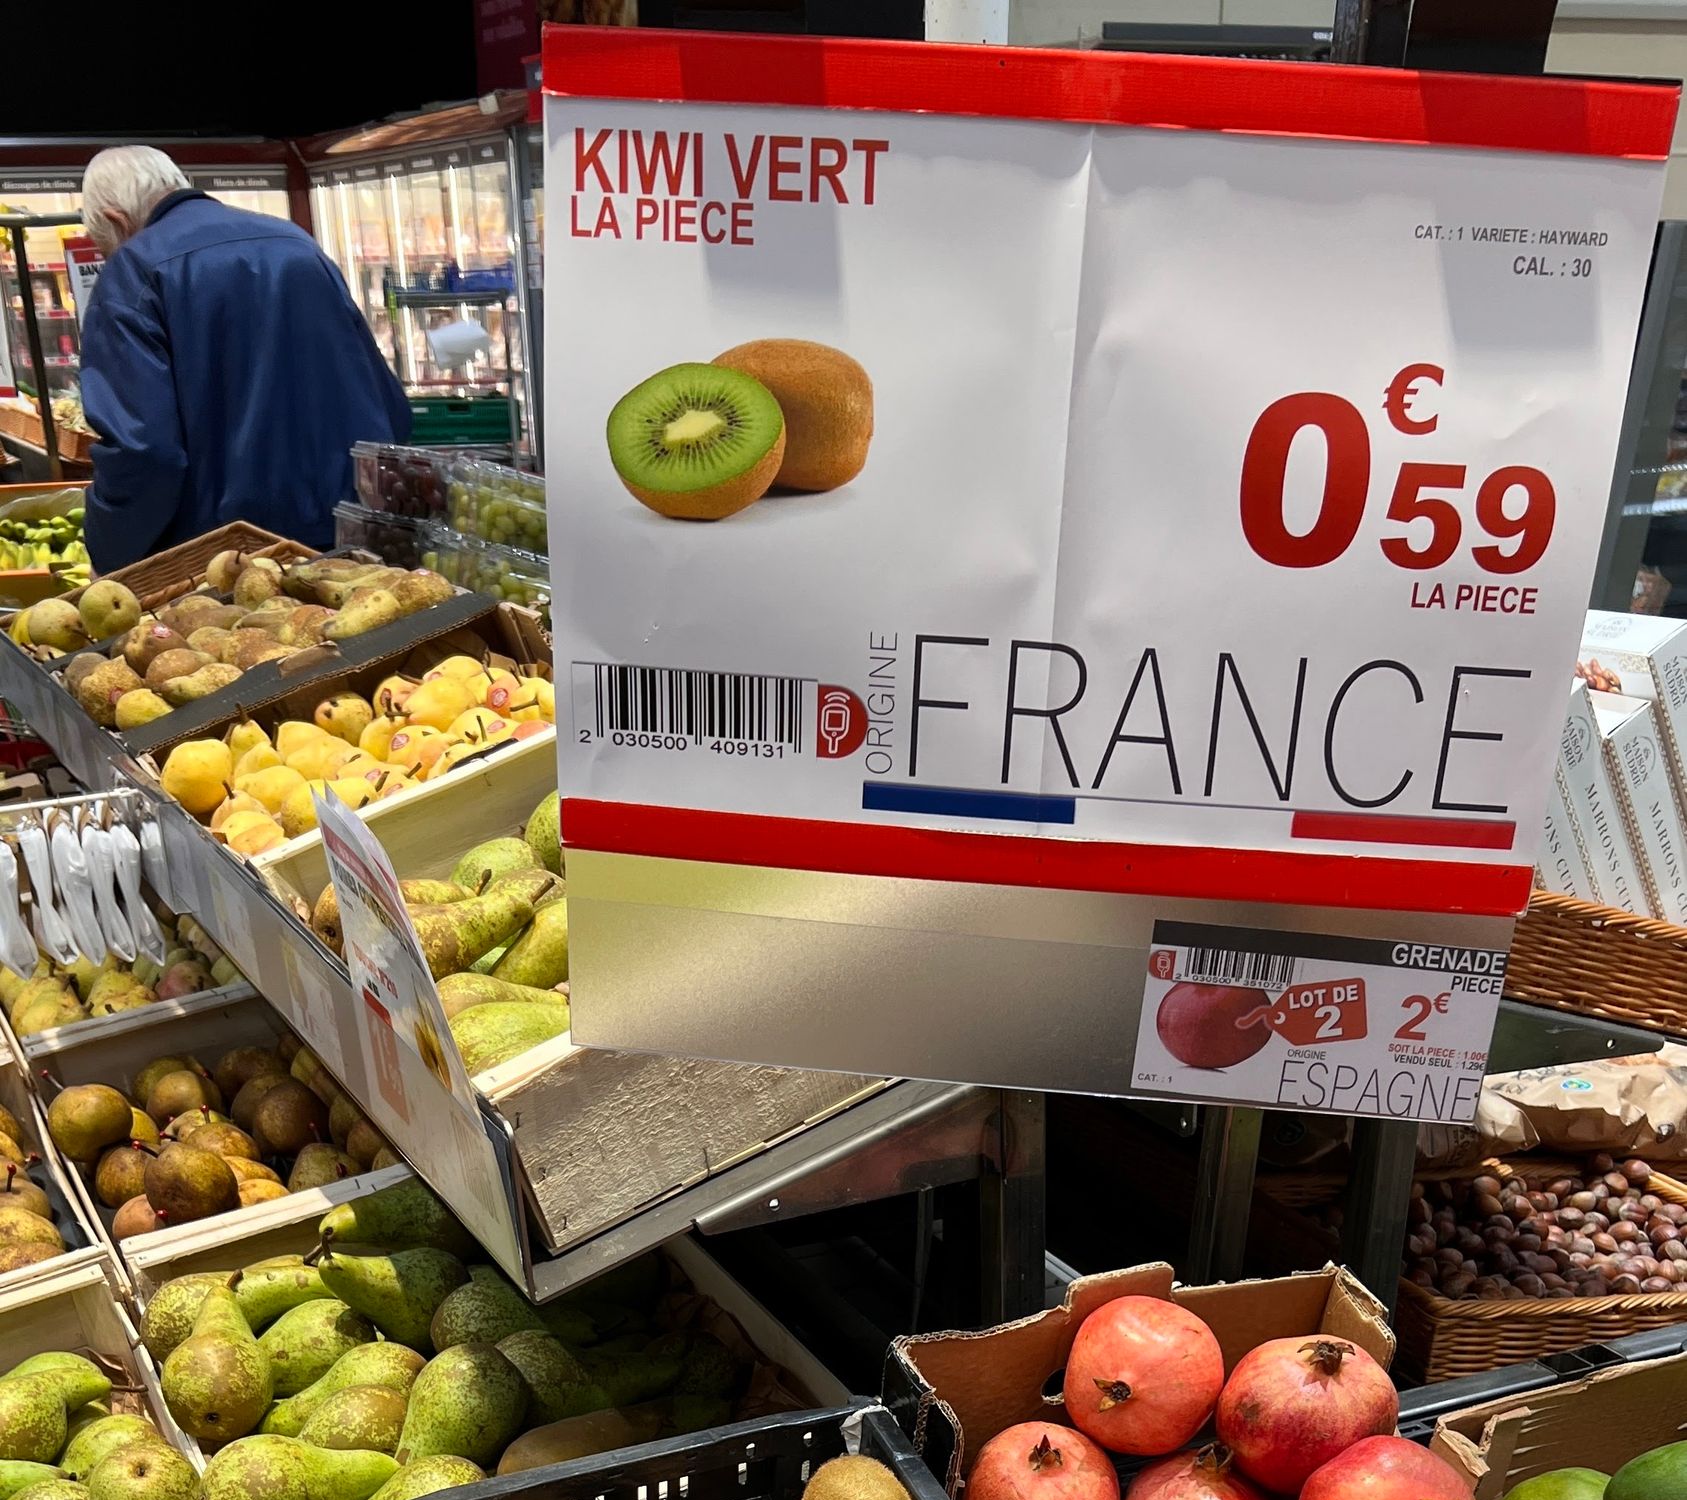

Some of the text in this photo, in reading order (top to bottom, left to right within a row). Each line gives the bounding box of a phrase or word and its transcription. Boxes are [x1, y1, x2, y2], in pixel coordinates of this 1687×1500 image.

[574, 127, 890, 206] KIWI VERT
[570, 195, 754, 245] LA PIECE
[1415, 225, 1445, 240] CAT.
[1457, 226, 1464, 240] 1
[1471, 226, 1529, 243] VARIETE
[1539, 230, 1608, 247] HAYWARD
[1513, 255, 1553, 276] CAL.
[1571, 258, 1592, 277] 30
[1410, 582, 1538, 615] LA PIECE
[864, 631, 898, 775] ORIGINE
[908, 633, 1532, 814] FRANCE
[579, 729, 785, 760] 2 030500 409131
[1585, 782, 1621, 873] MARRONS
[1649, 800, 1682, 889] MARRONS
[1556, 858, 1577, 899] CUIT
[1391, 943, 1506, 975] GRENADE
[1288, 984, 1359, 1010] LOT DE
[1451, 975, 1502, 995] PIECE
[1314, 1005, 1344, 1040] 2
[1287, 1048, 1327, 1061] ORIGINE
[1388, 1043, 1411, 1055] SOIT
[1412, 1045, 1424, 1056] LA
[1426, 1047, 1456, 1059] PIECE
[1394, 1054, 1426, 1066] VENDU
[1428, 1057, 1452, 1069] SEUL
[1276, 1060, 1480, 1122] ESPAGNE
